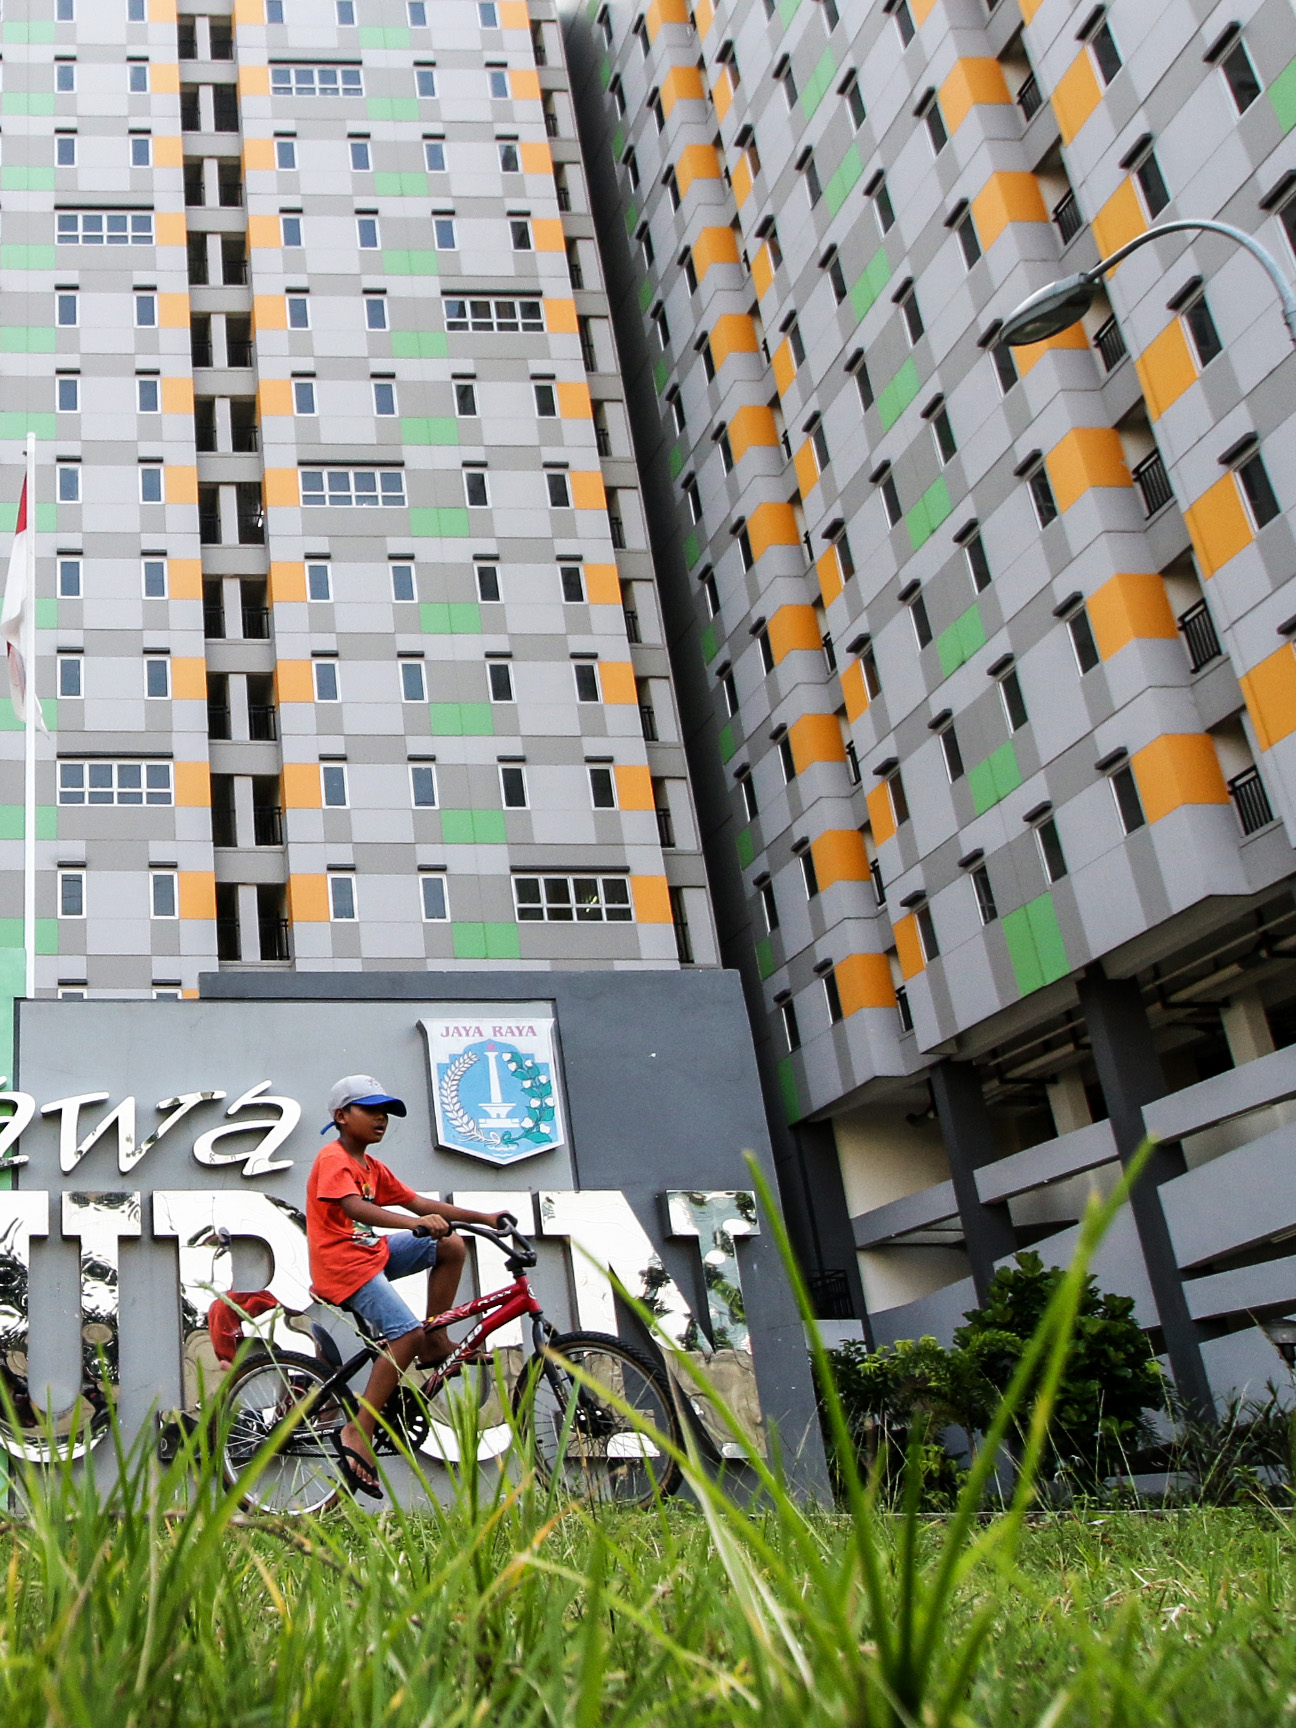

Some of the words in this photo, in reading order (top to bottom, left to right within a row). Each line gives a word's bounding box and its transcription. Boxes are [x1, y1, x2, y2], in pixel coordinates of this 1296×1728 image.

[441, 1026, 484, 1037] JAYA
[492, 1026, 537, 1037] RAYA
[437, 1323, 483, 1376] UNITED
